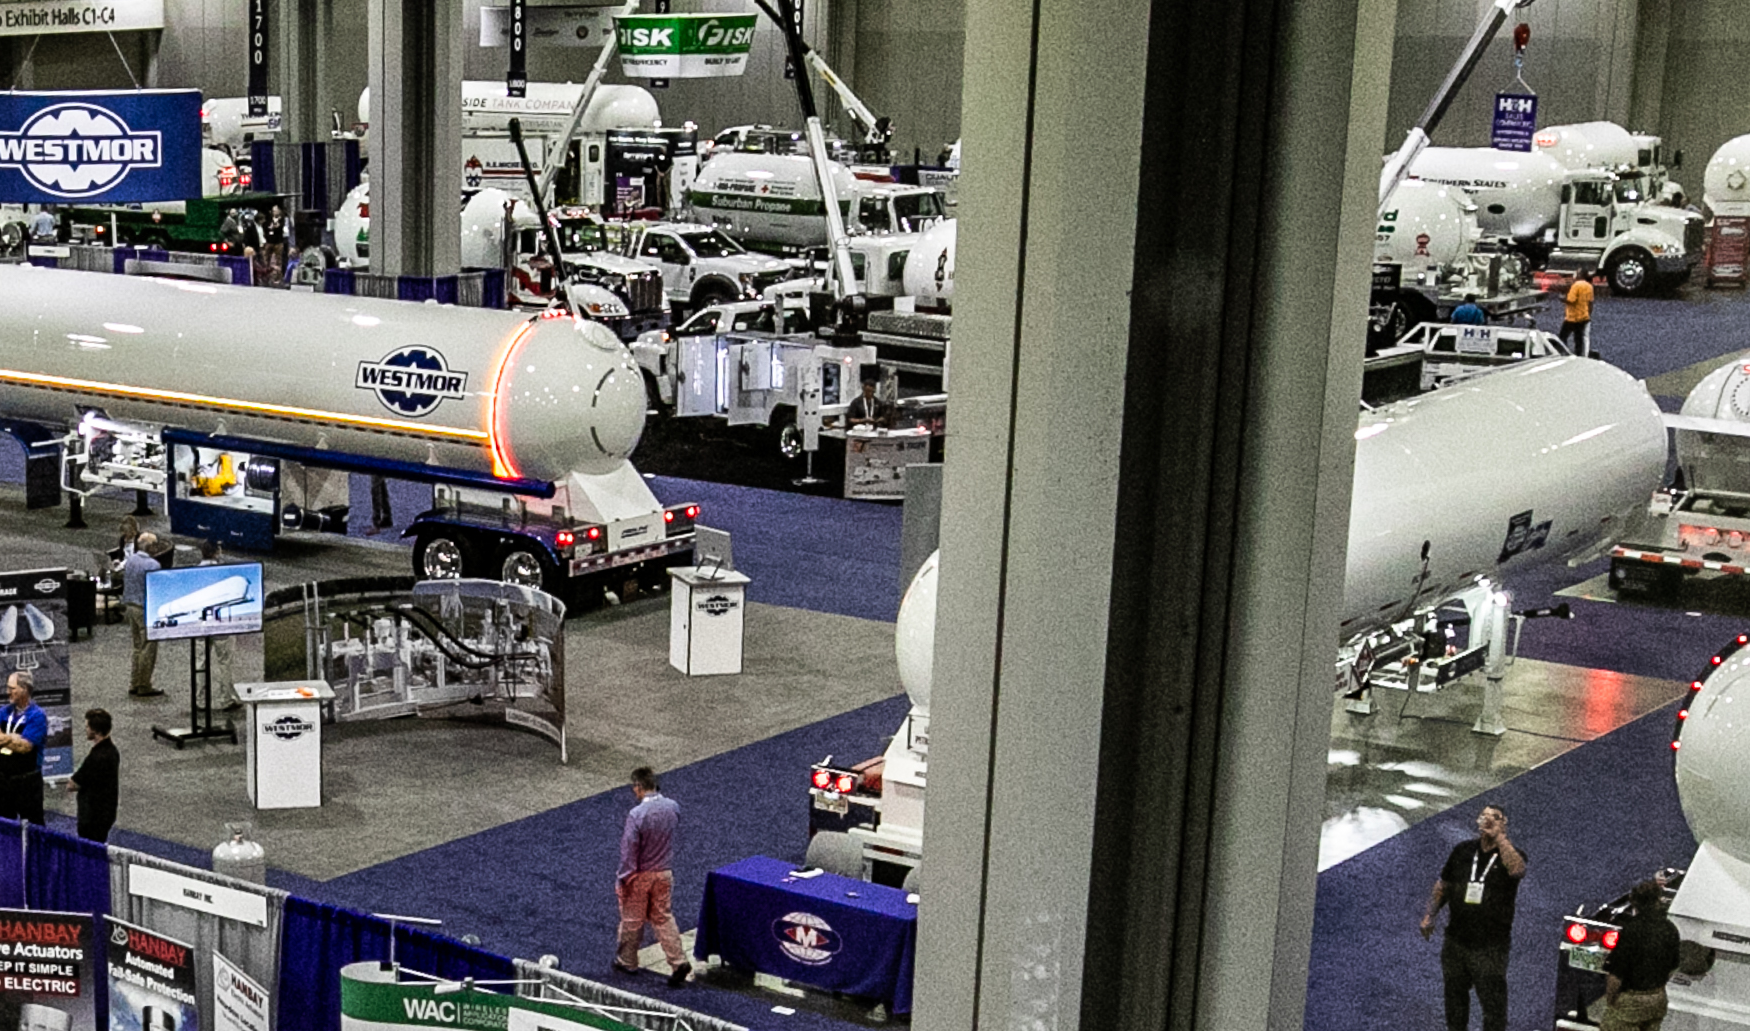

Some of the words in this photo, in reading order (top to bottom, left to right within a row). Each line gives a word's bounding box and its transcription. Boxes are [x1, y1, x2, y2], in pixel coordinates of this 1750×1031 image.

[5, 7, 50, 28] Exhibit
[52, 6, 80, 26] Halls
[82, 6, 116, 25] C1-C4
[254, 0, 263, 64] 1700
[1473, 179, 1507, 189] STATES
[711, 194, 752, 210] Suburban
[754, 196, 792, 213] Propane
[361, 366, 462, 392] WESTMOR
[263, 722, 314, 732] WESTMOR
[128, 929, 188, 967] HANBAY
[795, 925, 818, 948] M
[13, 942, 84, 961] Actuators
[15, 962, 26, 972] IT
[28, 963, 74, 976] SIMPLE
[125, 951, 175, 980] Automated
[4, 977, 77, 994] ELECTRIC
[108, 962, 145, 988] Fail-Safe
[146, 974, 196, 1005] Protection
[231, 972, 264, 1008] HANBAY
[402, 998, 455, 1023] WAC
